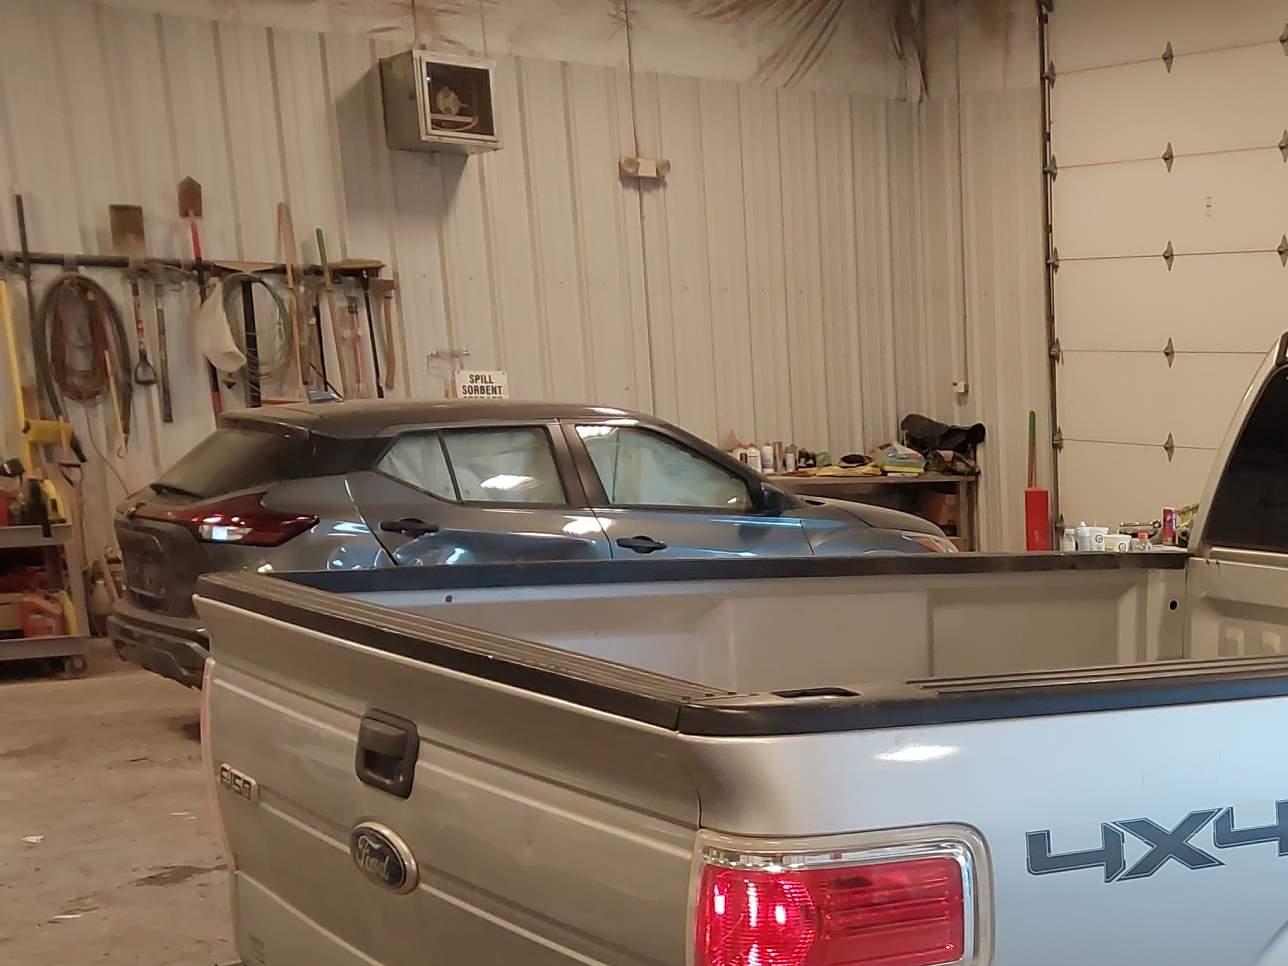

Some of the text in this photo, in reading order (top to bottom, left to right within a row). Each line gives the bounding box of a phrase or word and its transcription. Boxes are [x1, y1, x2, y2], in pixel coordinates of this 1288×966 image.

[468, 373, 494, 384] SPILL
[462, 384, 503, 395] SORBENT
[357, 835, 390, 881] Ford
